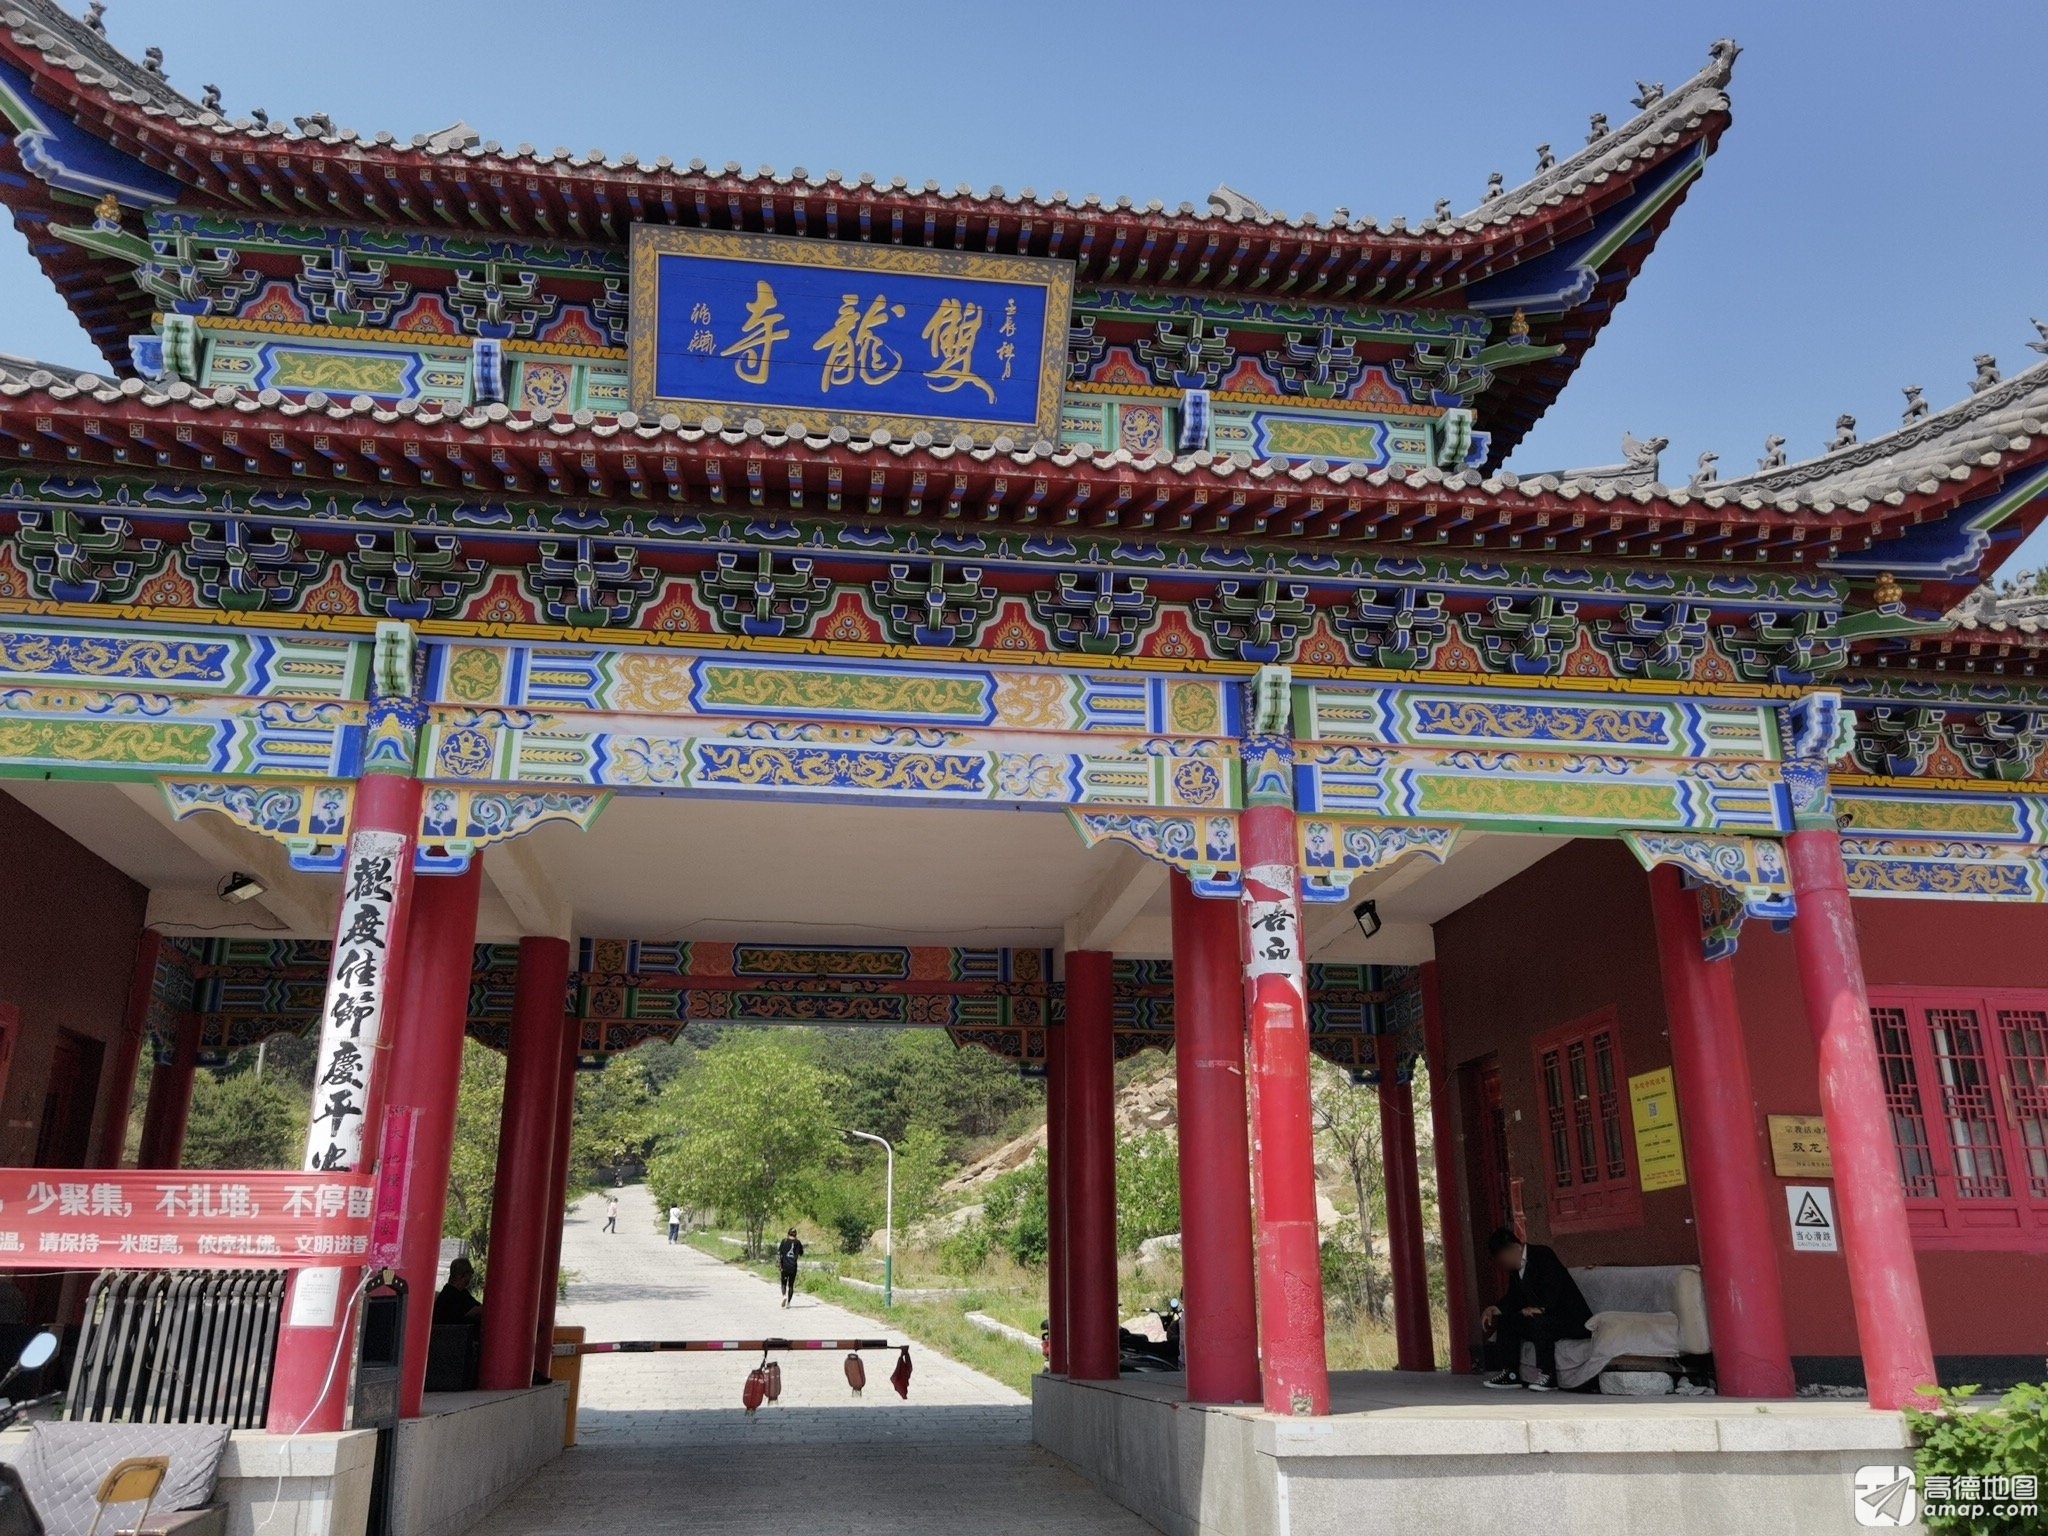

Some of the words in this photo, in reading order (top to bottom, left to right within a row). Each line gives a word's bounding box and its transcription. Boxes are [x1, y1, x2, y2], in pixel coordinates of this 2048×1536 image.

[1785, 1125, 1827, 1135] 宗教活动
[1792, 1142, 1830, 1153] 双龙
[1796, 1231, 1831, 1241] 当心滑跌
